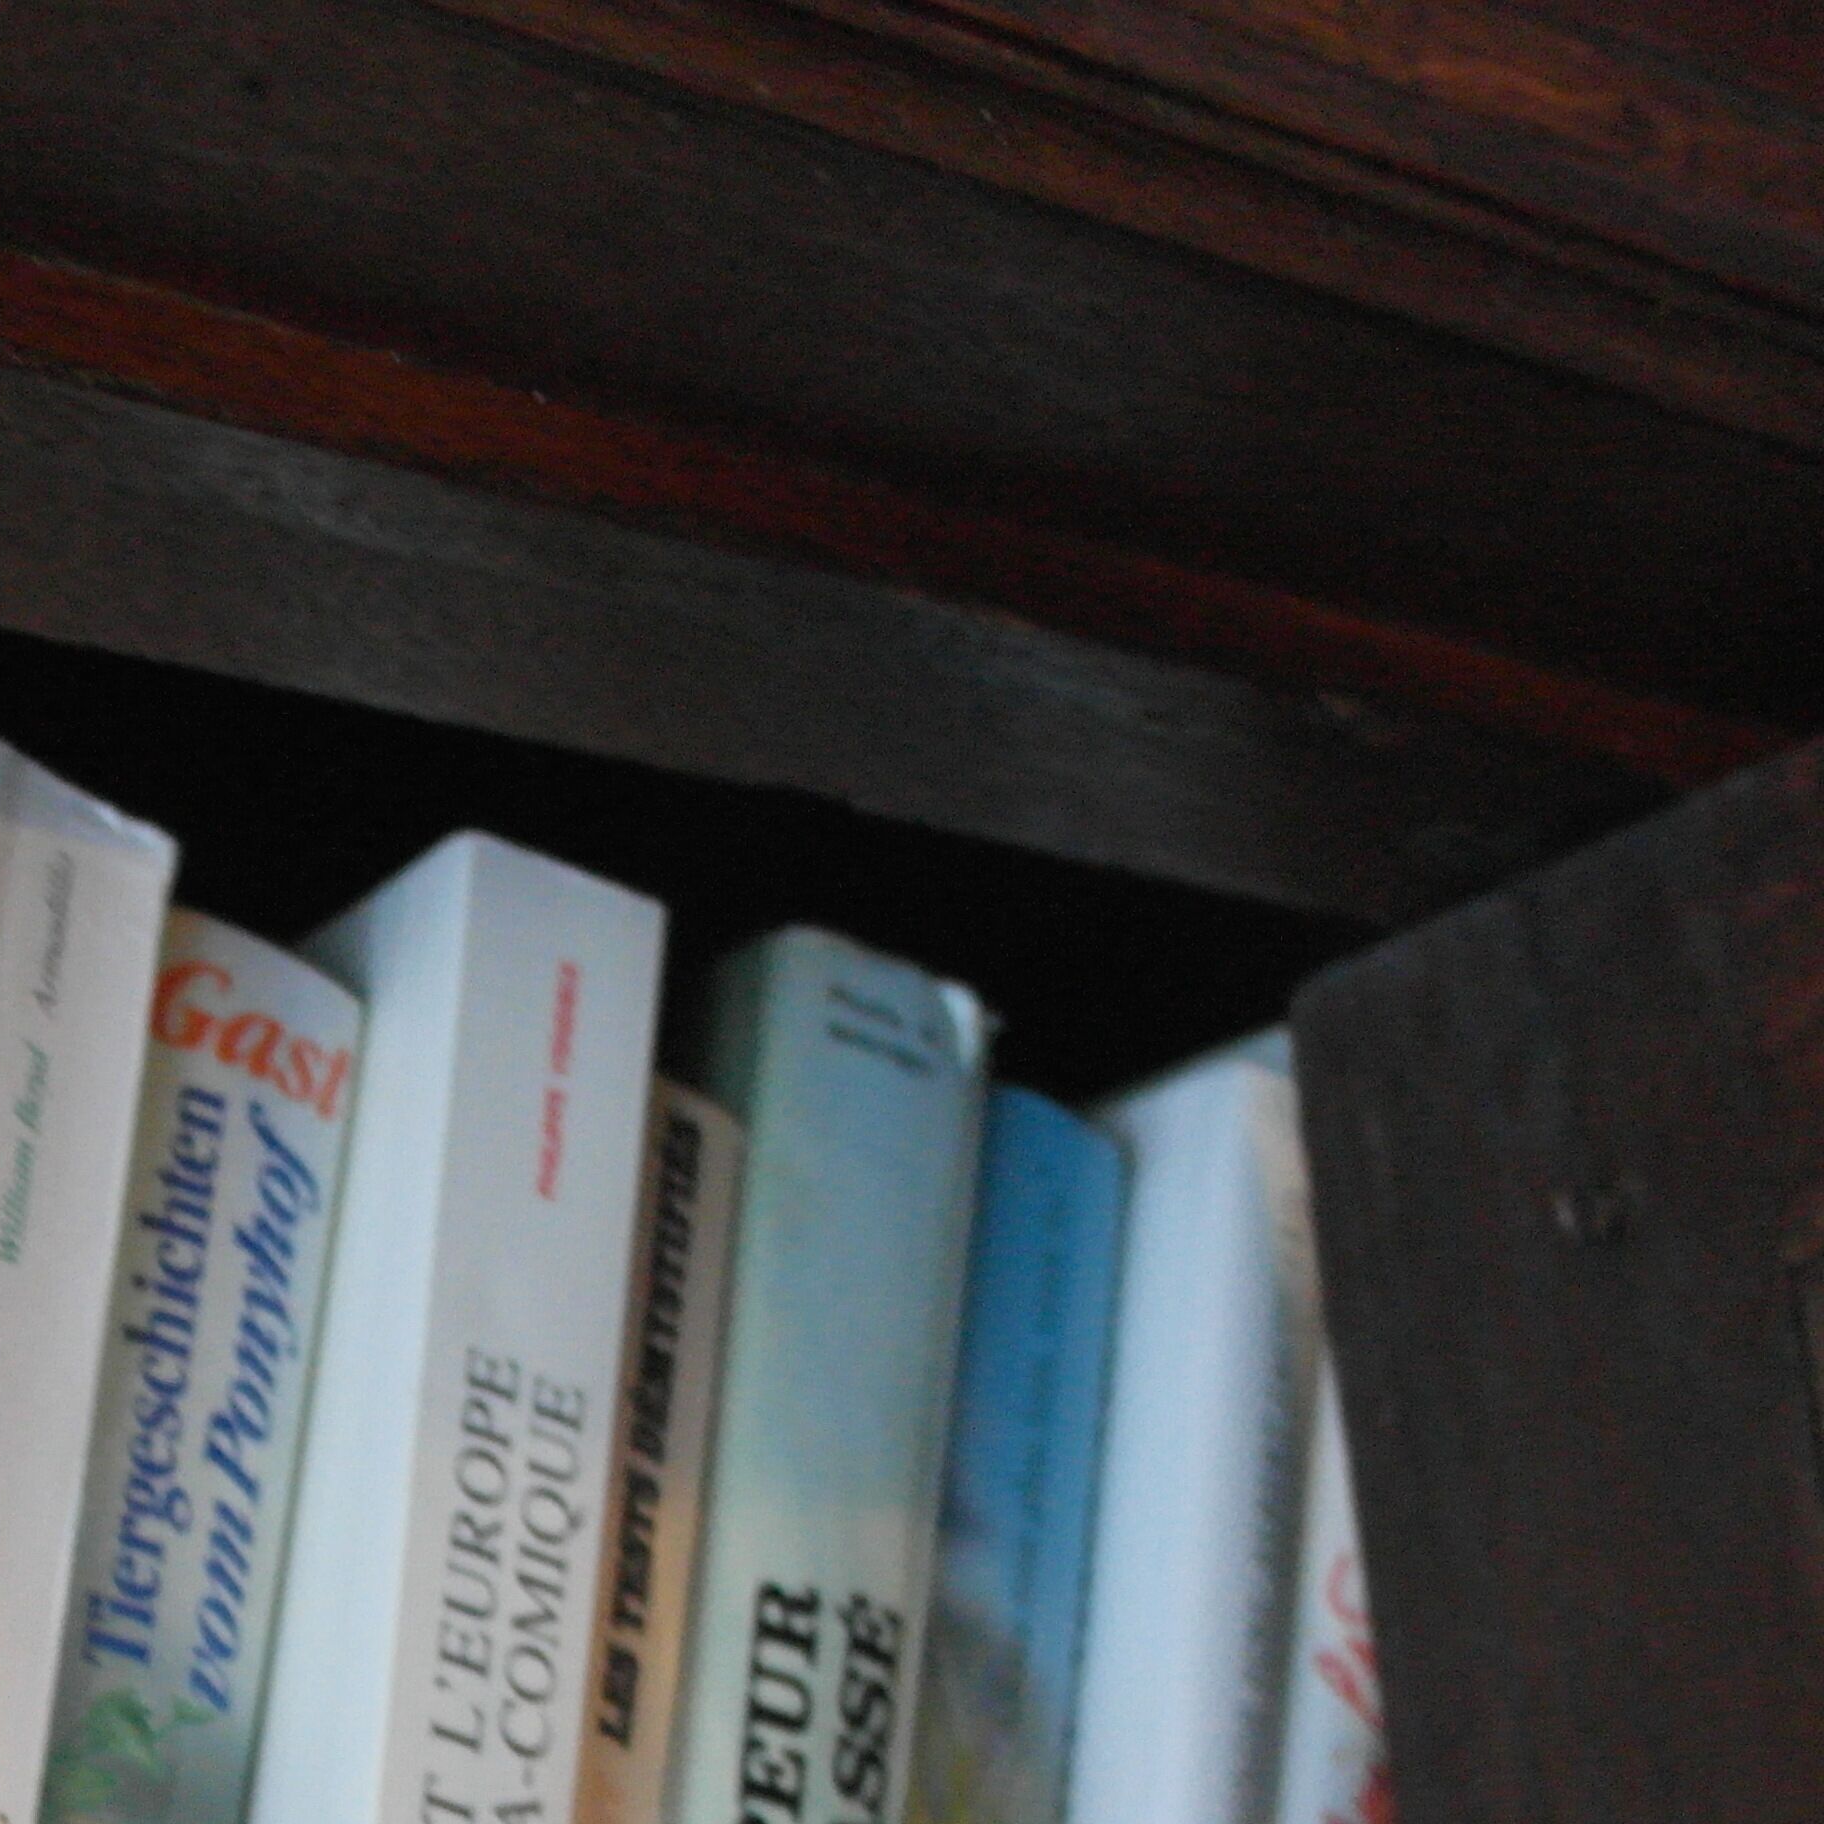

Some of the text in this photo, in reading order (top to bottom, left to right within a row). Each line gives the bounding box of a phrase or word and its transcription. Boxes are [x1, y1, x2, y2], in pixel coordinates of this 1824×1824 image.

[151, 959, 350, 1120] Gast
[82, 1086, 226, 1666] Tiergeschichten
[188, 1100, 320, 1708] vom Ponyhof
[430, 1347, 522, 1754] L'EUROPE
